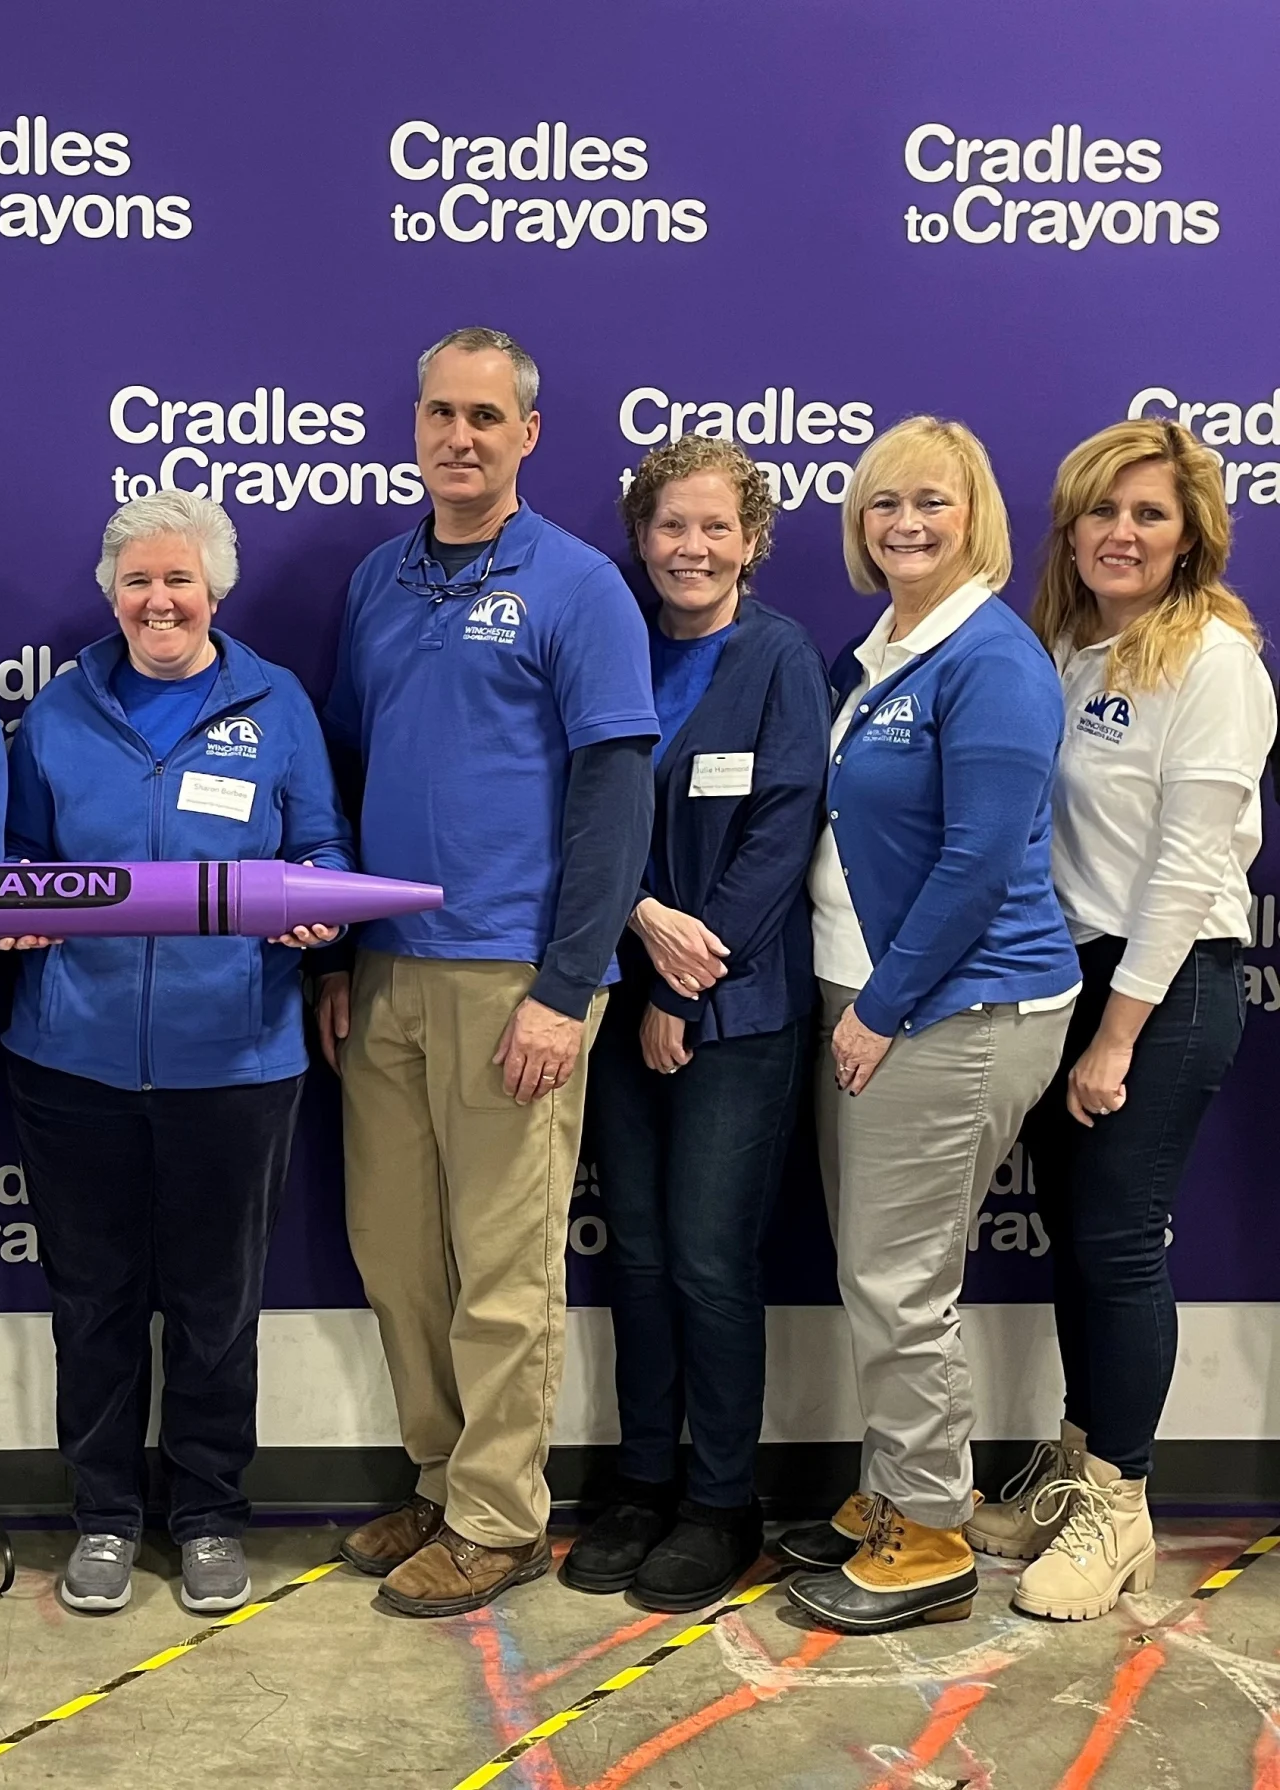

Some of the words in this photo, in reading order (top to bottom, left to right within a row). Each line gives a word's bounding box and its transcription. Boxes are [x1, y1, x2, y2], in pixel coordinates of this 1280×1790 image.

[390, 120, 649, 181] Cradles
[905, 123, 1162, 184] Cradles
[391, 203, 436, 243] to
[440, 182, 708, 250] Crayons
[904, 205, 949, 244] to
[952, 184, 1220, 251] Crayons
[109, 385, 366, 446] Cradles
[619, 387, 875, 446] Cradles
[112, 466, 157, 503] to
[159, 446, 425, 512] Crayons
